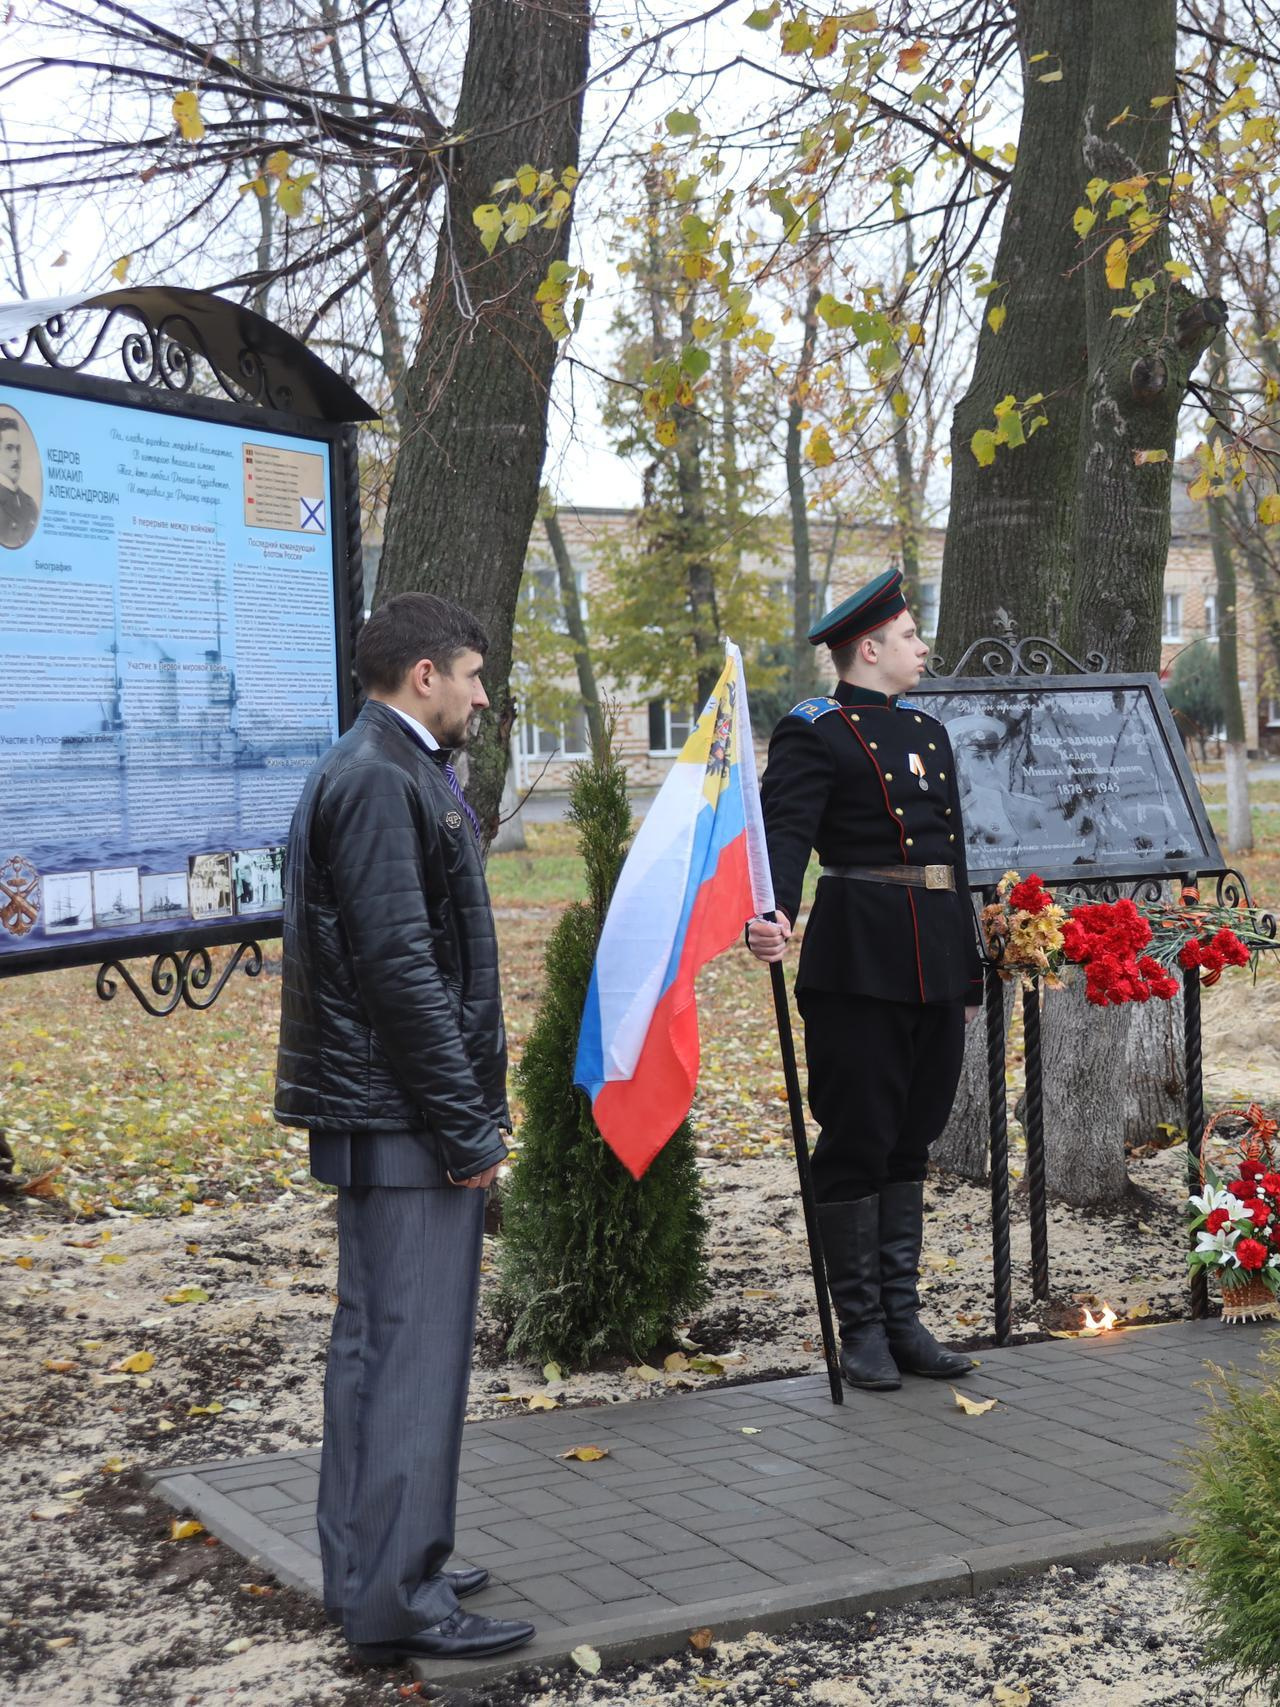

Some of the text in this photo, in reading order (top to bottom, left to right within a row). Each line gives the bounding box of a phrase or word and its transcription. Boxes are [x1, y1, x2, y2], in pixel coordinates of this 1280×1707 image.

[47, 448, 80, 465] КЕДРОВ
[48, 466, 83, 483] МИХАИЛ
[49, 484, 120, 504] АЛЕКСАНДРОВИЧ
[35, 559, 73, 573] Биография
[799, 703, 818, 717] 72
[1030, 733, 1117, 748] Вице-адмирал
[1060, 749, 1097, 761] Кедров
[1022, 765, 1064, 777] Михаил
[1056, 783, 1083, 795] 1878
[1096, 782, 1120, 794] 1945
